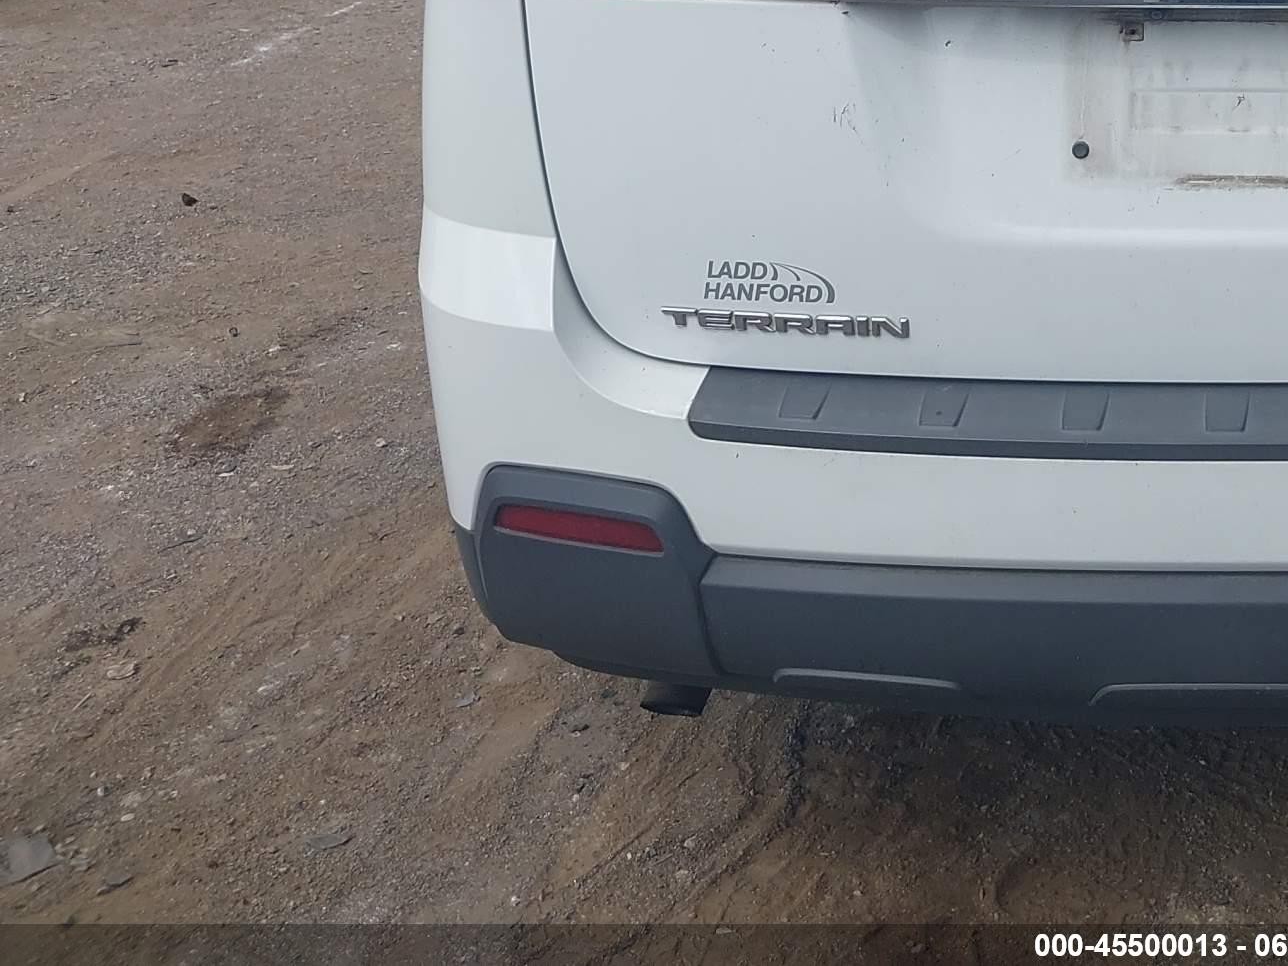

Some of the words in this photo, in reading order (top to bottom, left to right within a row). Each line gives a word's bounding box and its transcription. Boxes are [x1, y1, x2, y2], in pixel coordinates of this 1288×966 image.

[707, 260, 768, 280] LADD
[703, 281, 823, 303] HANFORD
[661, 306, 910, 338] TERRAIN
